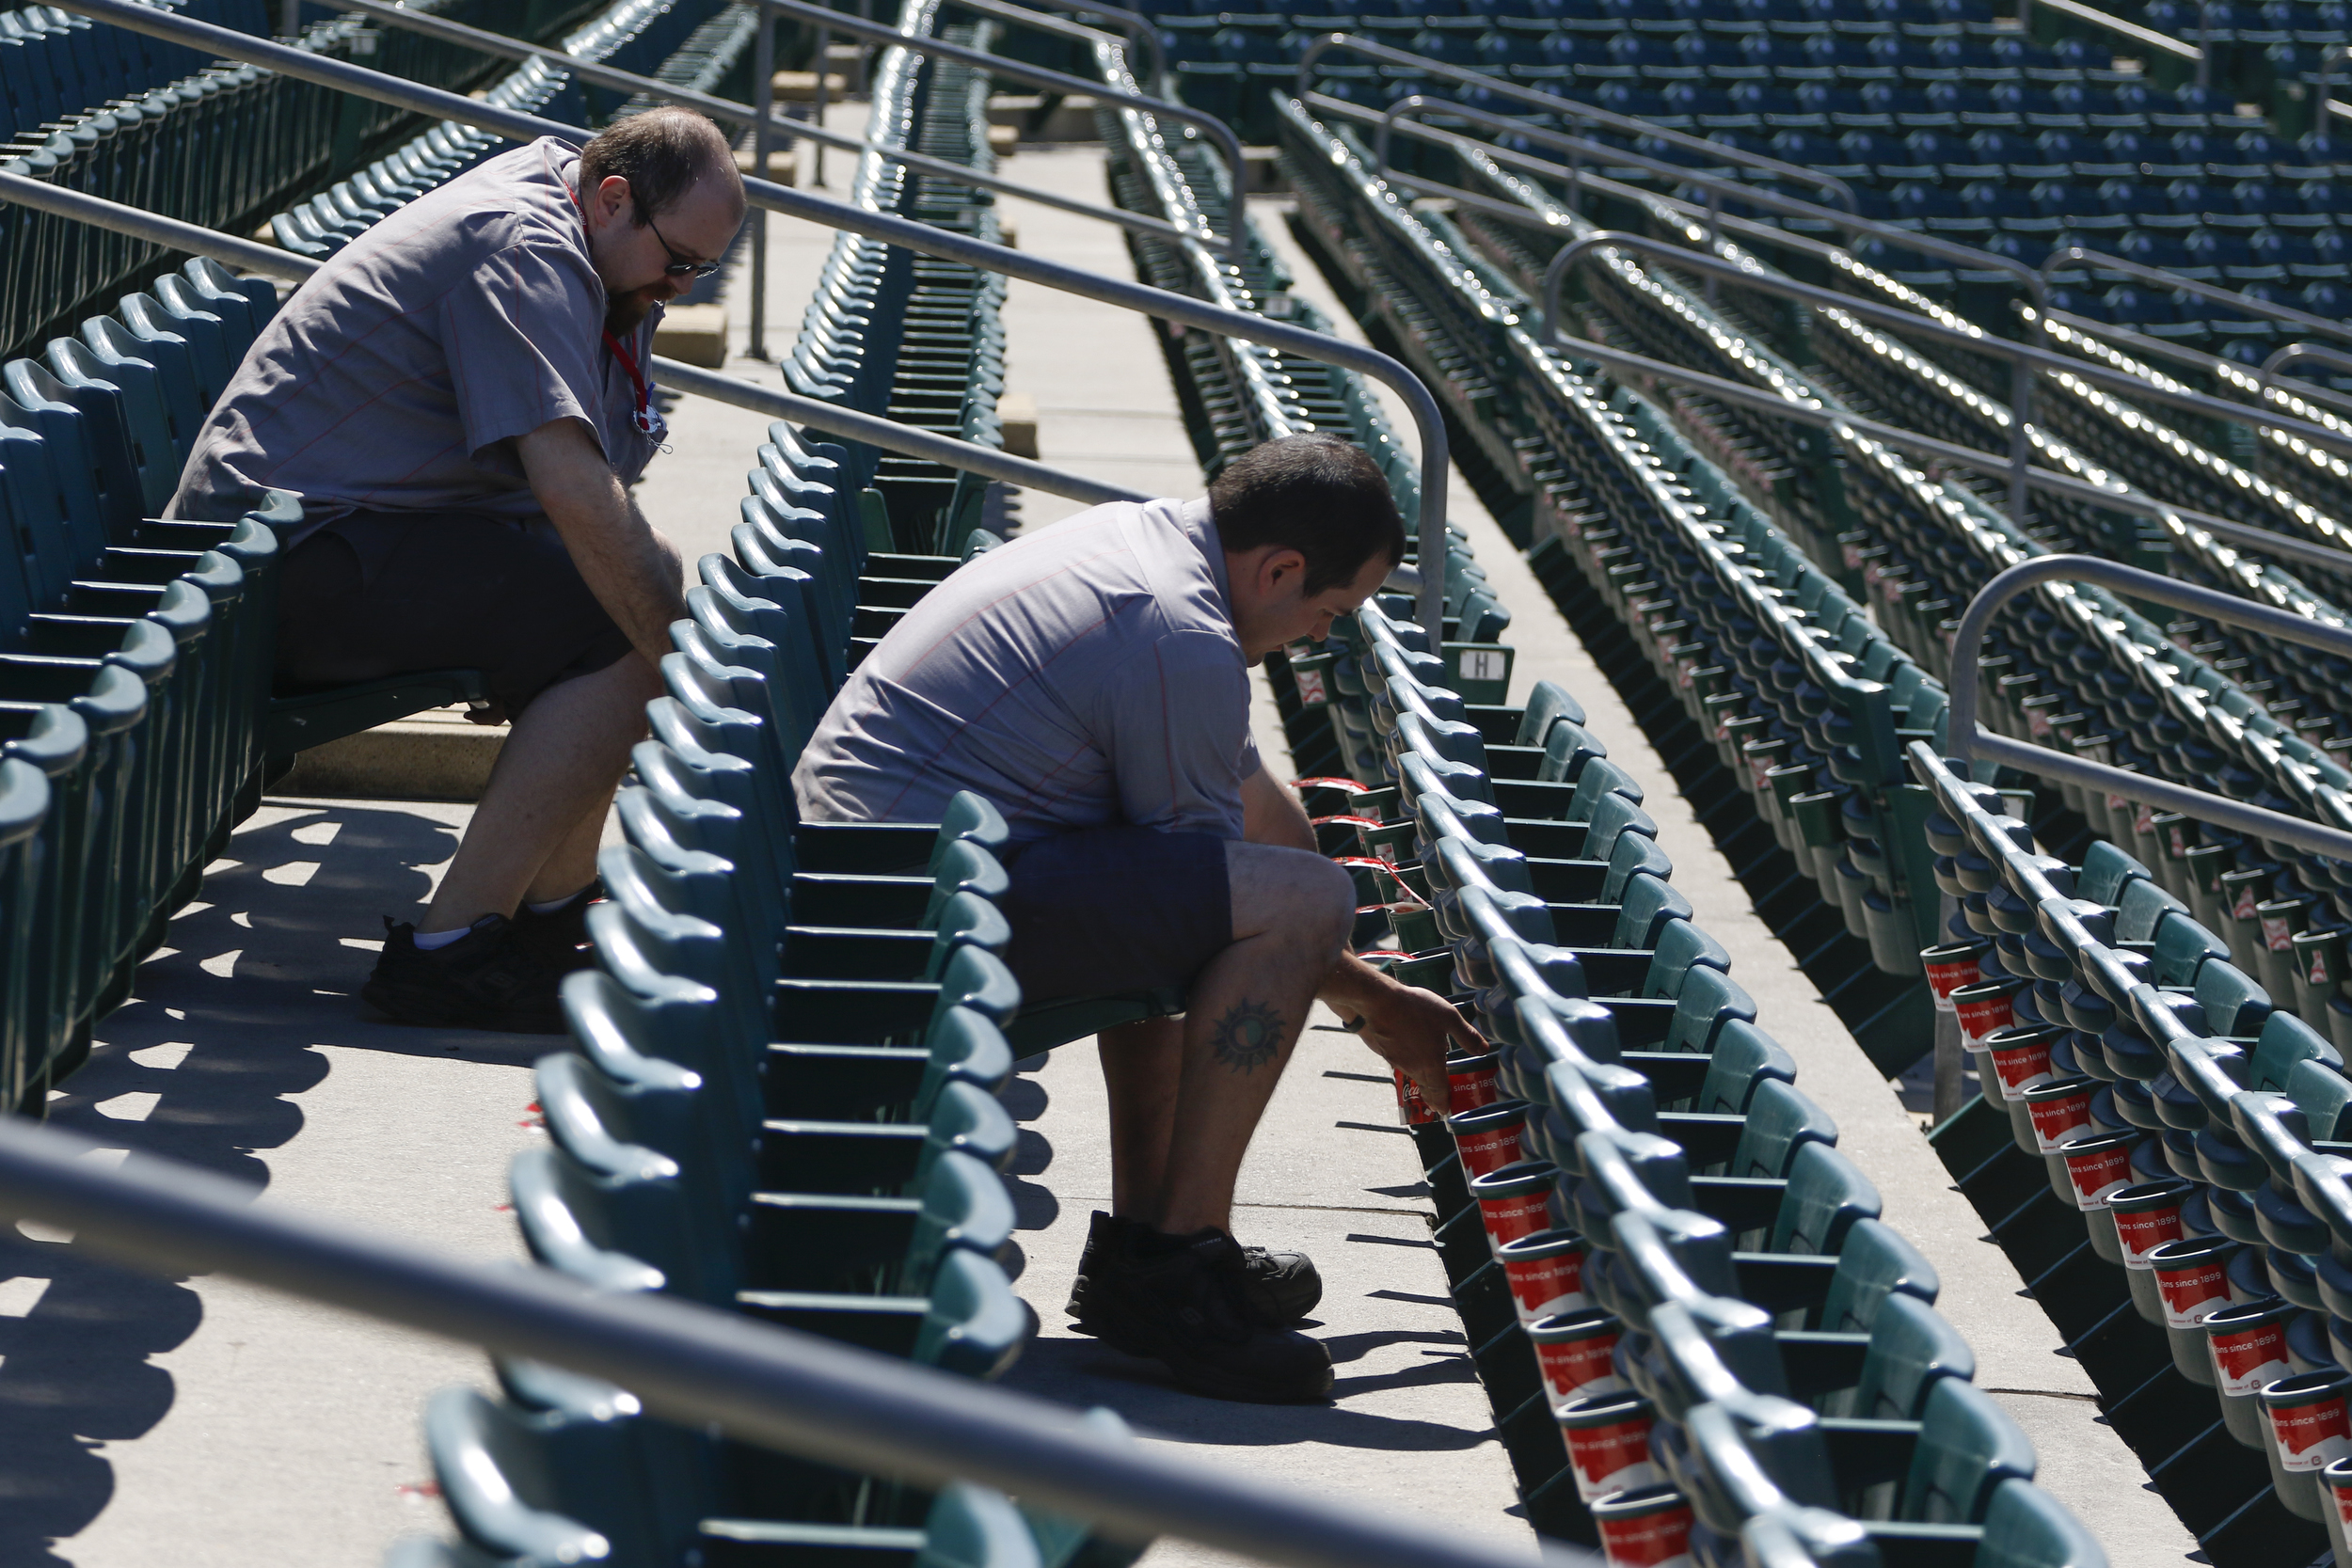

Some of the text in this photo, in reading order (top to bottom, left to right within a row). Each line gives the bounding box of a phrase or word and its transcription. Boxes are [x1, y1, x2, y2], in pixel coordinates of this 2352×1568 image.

[1474, 651, 1488, 677] H
[1941, 970, 1959, 978] since
[1961, 966, 1979, 975] 1899
[1971, 1009, 1991, 1018] since
[1992, 1004, 2010, 1014] 1899
[2008, 1056, 2027, 1065] since
[2028, 1051, 2047, 1061] 1899
[1454, 1078, 1494, 1092] since 189
[2045, 1107, 2065, 1117] since
[2067, 1101, 2087, 1113] 1899
[1474, 1142, 1498, 1152] since
[2083, 1162, 2104, 1171] since
[2105, 1156, 2124, 1167] 1899
[1499, 1209, 1523, 1218] since
[2133, 1220, 2154, 1229] since
[2156, 1215, 2177, 1227] 1899
[1526, 1271, 1550, 1281] since
[1552, 1264, 1578, 1276] 1899
[2175, 1278, 2199, 1288] since
[2200, 1272, 2221, 1283] 1899
[2230, 1342, 2253, 1353] since
[2254, 1334, 2277, 1347] 1899
[1557, 1354, 1584, 1365] since
[2290, 1416, 2314, 1427] since
[2316, 1408, 2340, 1421] 1899
